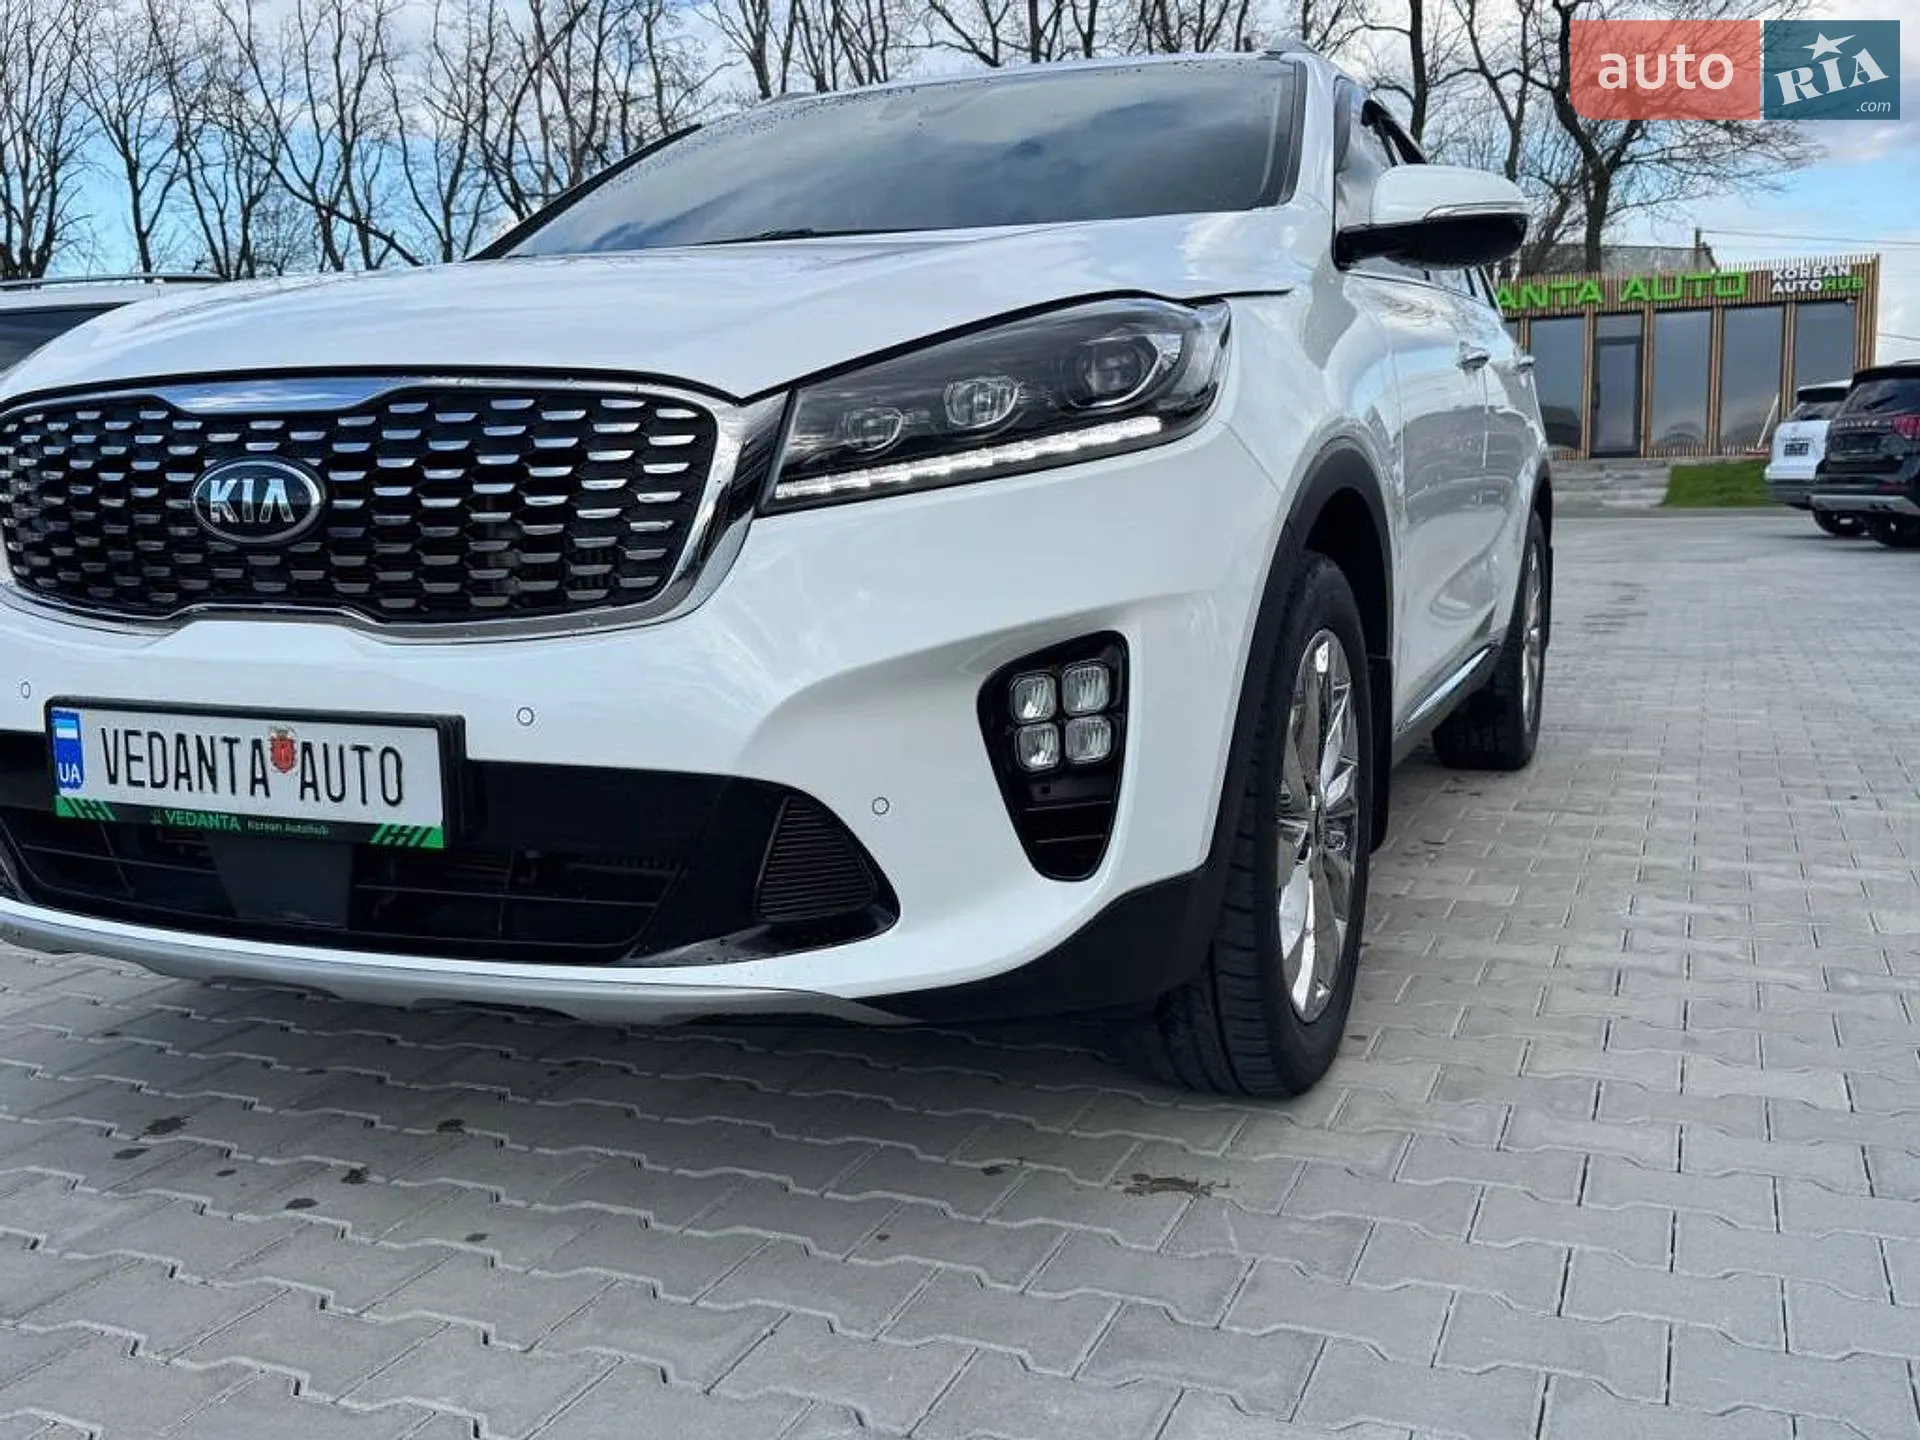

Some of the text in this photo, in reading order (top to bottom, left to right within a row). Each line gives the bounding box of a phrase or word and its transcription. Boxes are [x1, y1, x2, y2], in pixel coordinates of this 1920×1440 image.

[1772, 264, 1851, 281] KOREAN
[1620, 271, 1745, 302] AUTO
[1771, 276, 1864, 294] AUTOHUB
[209, 478, 295, 523] KIA
[57, 761, 81, 785] UA
[100, 726, 405, 807] VEDANTA AUTO
[164, 809, 241, 831] VEDANTA
[247, 819, 283, 832] Korean
